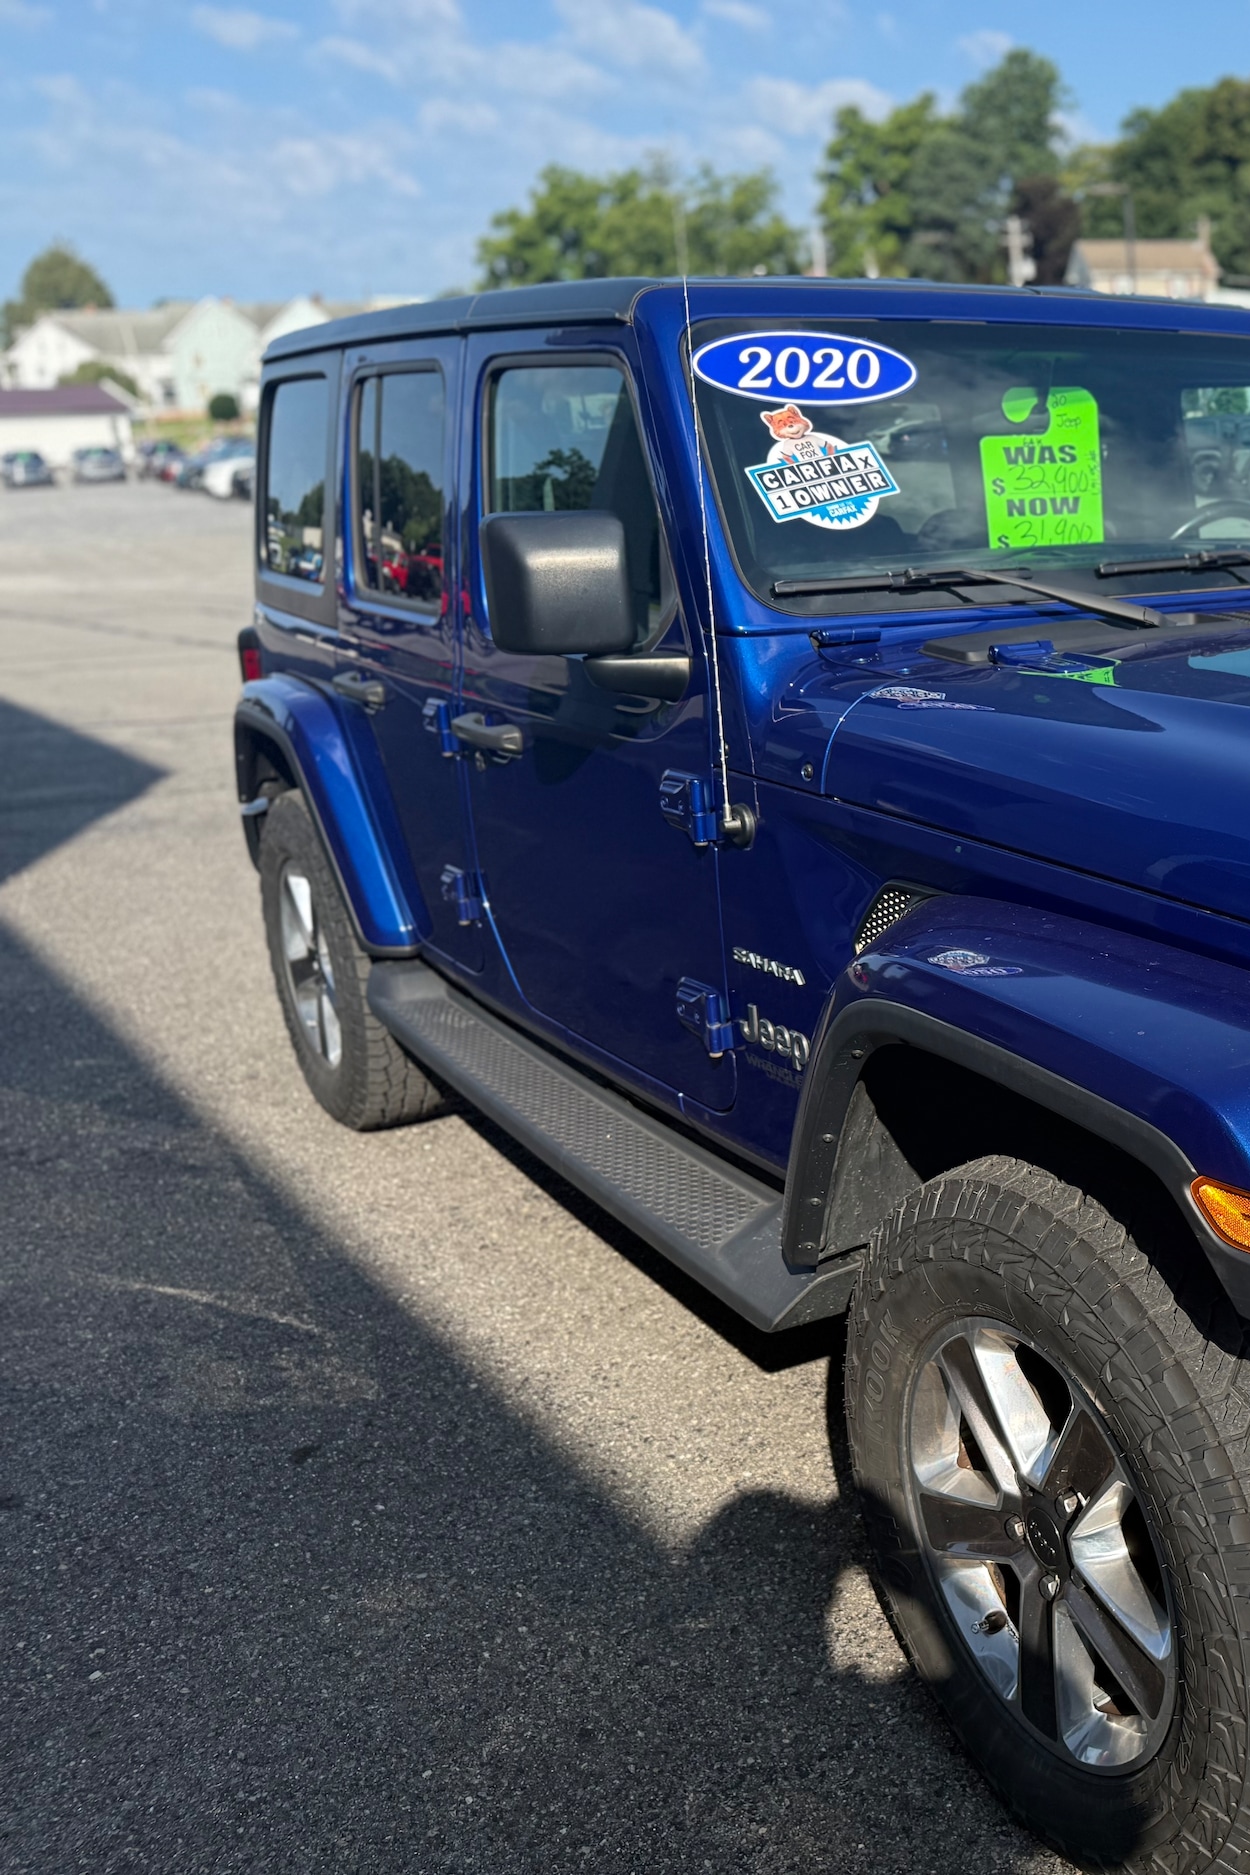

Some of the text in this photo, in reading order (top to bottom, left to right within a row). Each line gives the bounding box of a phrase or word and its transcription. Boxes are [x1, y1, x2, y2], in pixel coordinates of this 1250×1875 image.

[737, 347, 881, 389] 2020
[1056, 413, 1082, 431] Jeep
[794, 441, 814, 452] CAR
[800, 450, 819, 460] FOX
[1003, 444, 1078, 465] WAS
[762, 455, 874, 489] CARFAX
[776, 495, 791, 510] 1
[794, 473, 887, 506] OWNER
[1006, 496, 1081, 518] NOW
[732, 947, 806, 986] SAHARA
[739, 1003, 810, 1071] Jeep
[745, 1050, 804, 1088] WRANGLE
